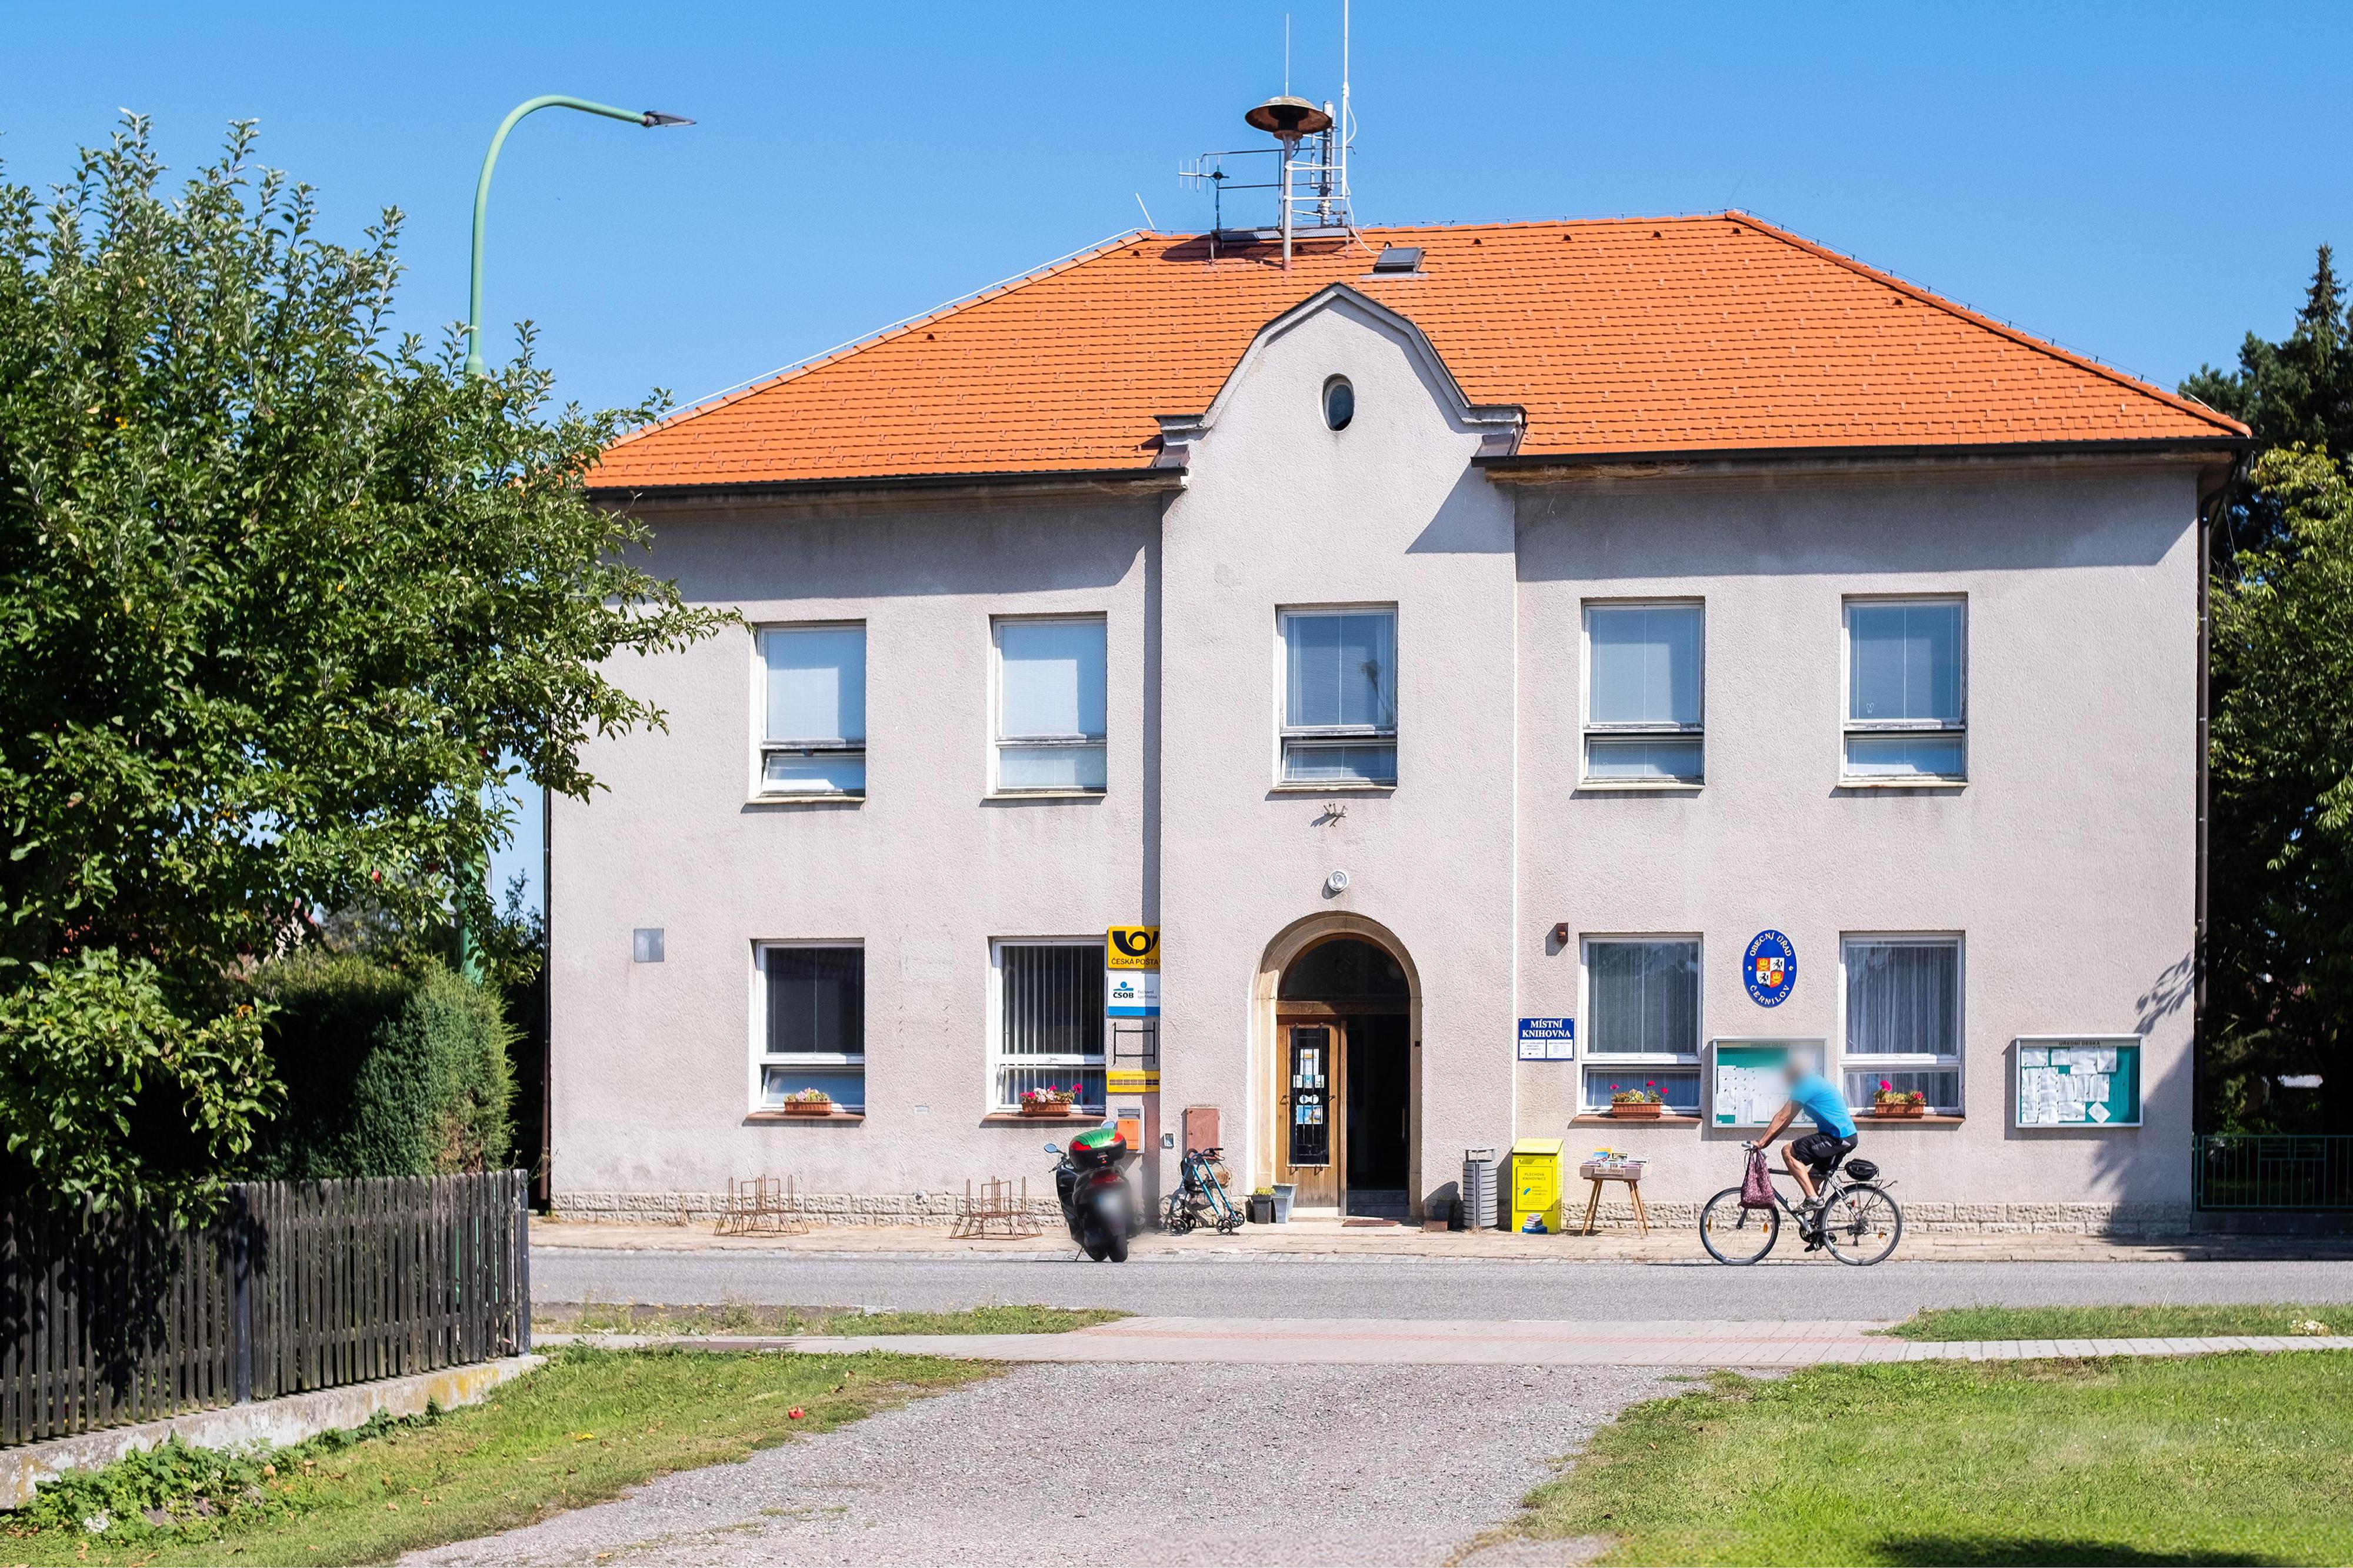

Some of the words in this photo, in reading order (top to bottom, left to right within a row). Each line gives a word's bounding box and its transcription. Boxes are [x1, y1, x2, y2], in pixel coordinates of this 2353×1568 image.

[1749, 932, 1775, 956] OBECNÍ
[1750, 985, 1789, 1005] ČERNILOV
[1530, 1019, 1563, 1028] MÍSTNÍ
